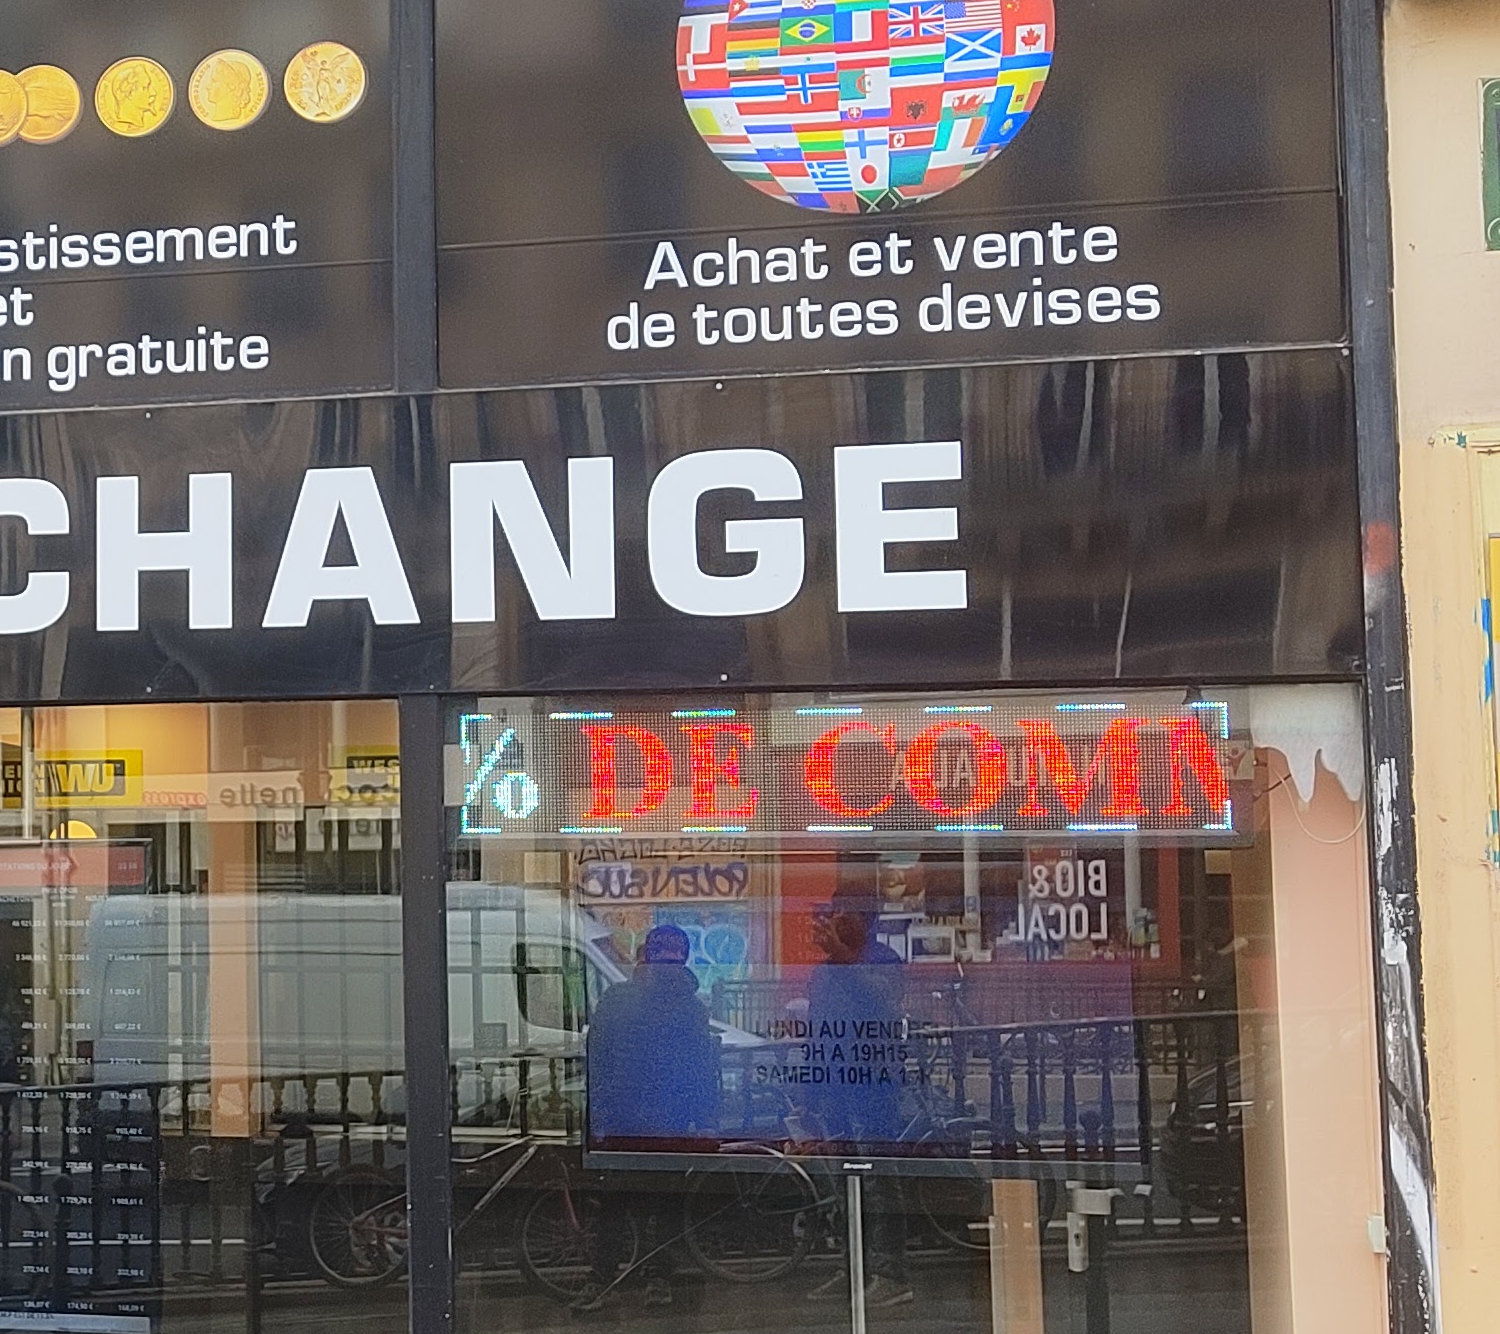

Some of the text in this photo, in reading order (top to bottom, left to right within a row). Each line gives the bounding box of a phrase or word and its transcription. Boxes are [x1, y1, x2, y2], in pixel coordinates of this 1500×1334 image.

[644, 221, 1119, 290] Achat et vente
[606, 278, 1161, 350] de toutes devises
[46, 328, 269, 392] gratuite
[581, 722, 758, 819] DE
[756, 1020, 813, 1039] LUNDI
[820, 1022, 845, 1038] AU
[832, 1044, 844, 1061] A
[852, 1044, 908, 1062] 19H15
[756, 1066, 830, 1084] SAMEDI
[839, 1066, 871, 1084] 10H
